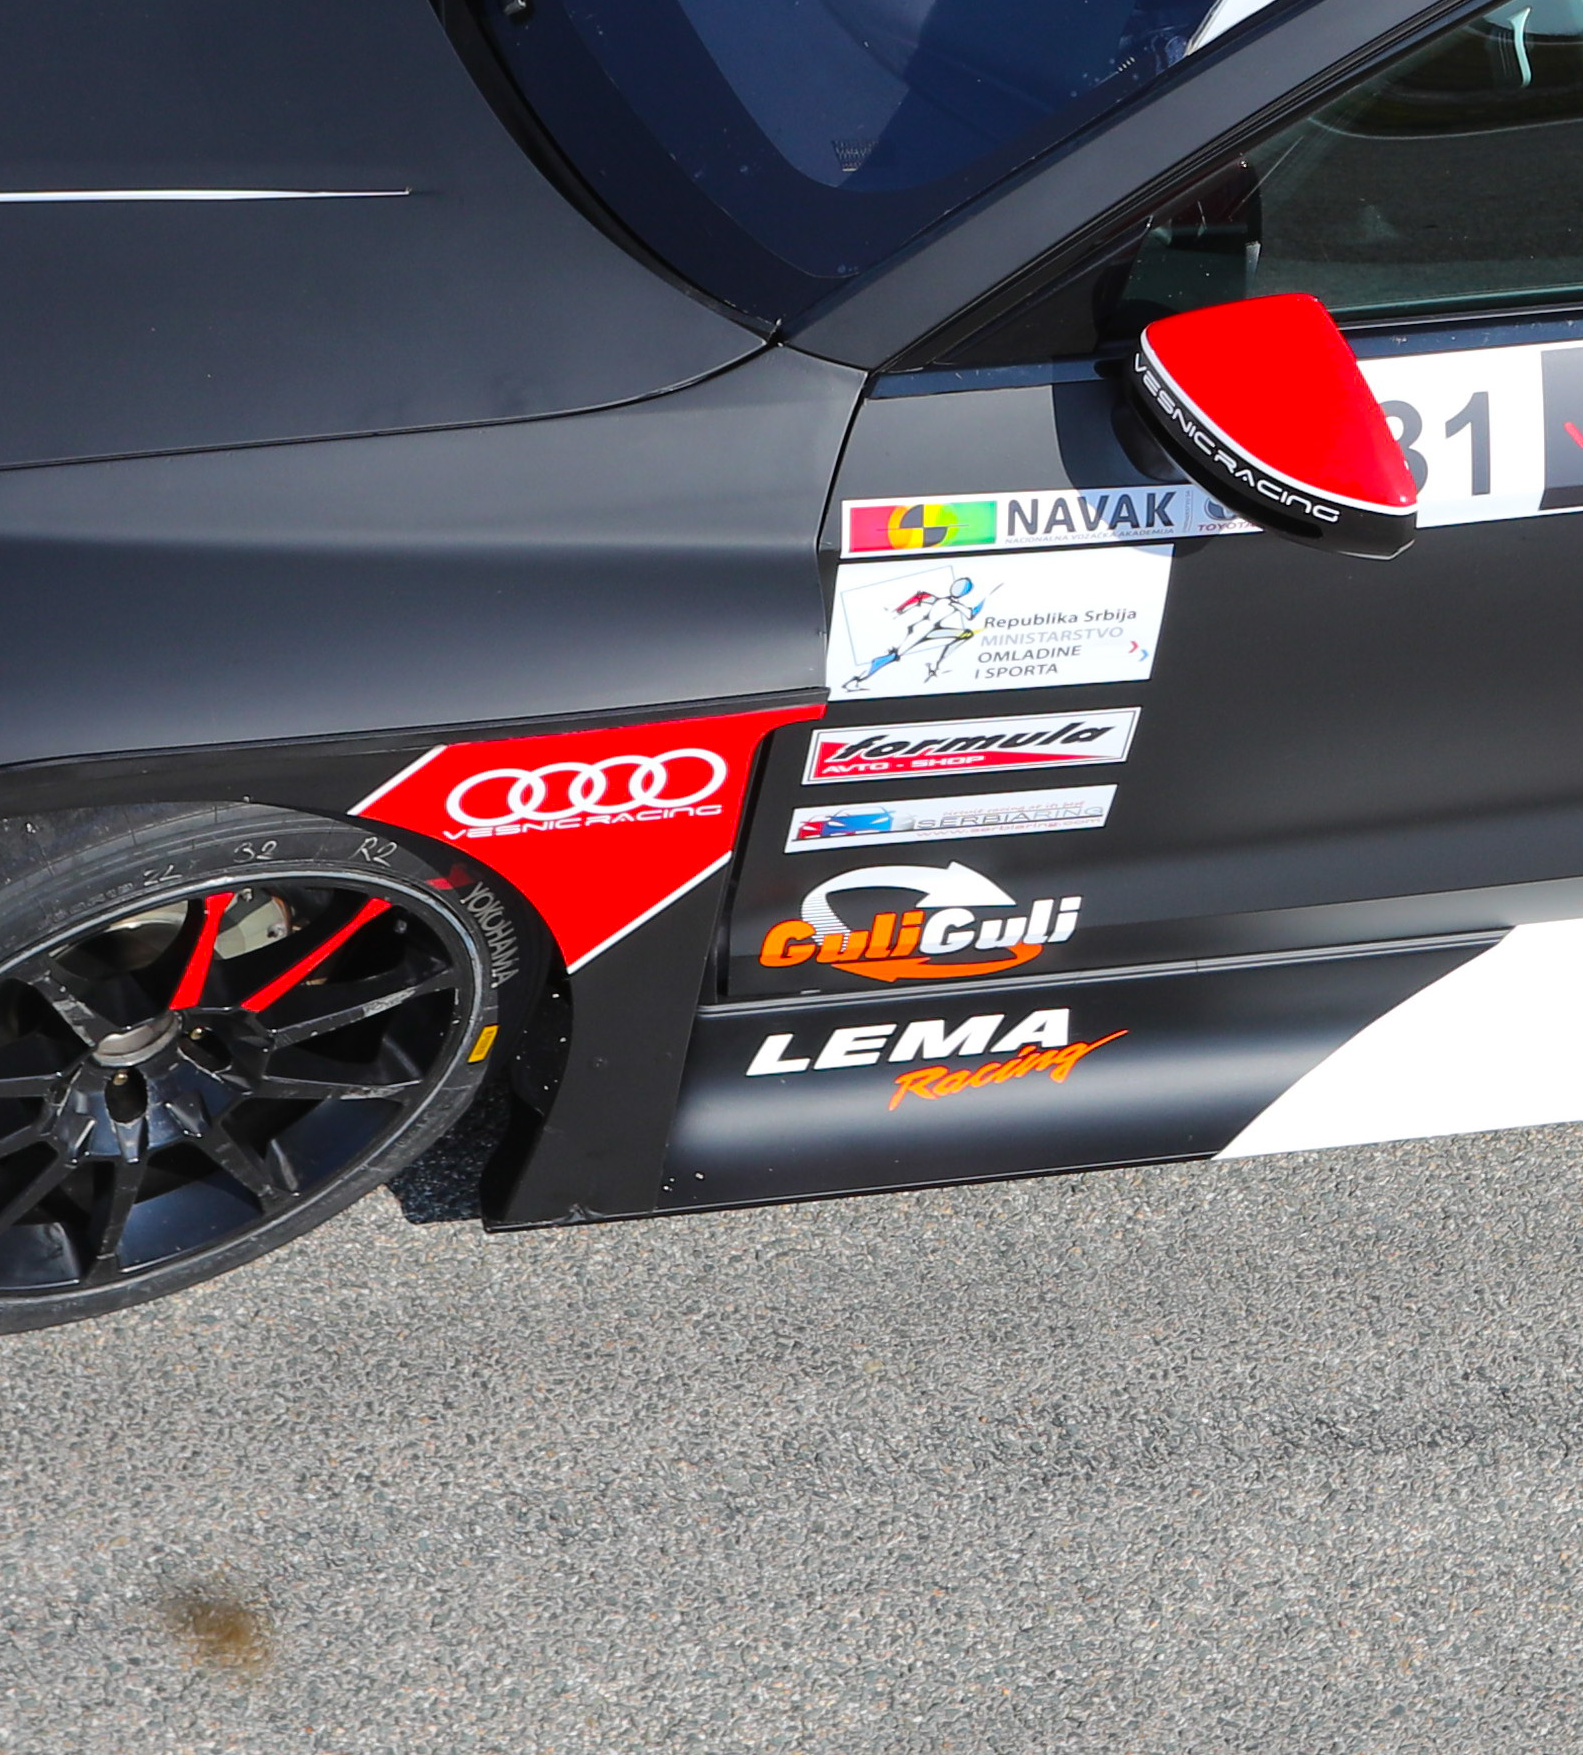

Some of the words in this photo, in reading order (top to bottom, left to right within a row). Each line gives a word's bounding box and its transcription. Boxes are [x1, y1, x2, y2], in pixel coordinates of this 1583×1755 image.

[1134, 352, 1215, 456] VESNIC
[1213, 451, 1340, 523] RACING
[1007, 491, 1177, 536] NAVAK
[980, 626, 1125, 647] MINISTARSTVO
[984, 612, 1078, 631] Republika
[1084, 608, 1138, 623] Srbija
[977, 645, 1082, 663] OMLADINE
[984, 664, 1058, 678] SPORTA
[825, 722, 1116, 762] formula
[911, 755, 985, 768] SHOP
[443, 816, 582, 840] VESNIC
[585, 804, 723, 827] RACING
[917, 806, 1104, 829] SERBIARING
[460, 882, 521, 988] YOKOHAMA
[746, 1008, 1072, 1077] LEMA
[888, 1029, 1129, 1111] Racing
